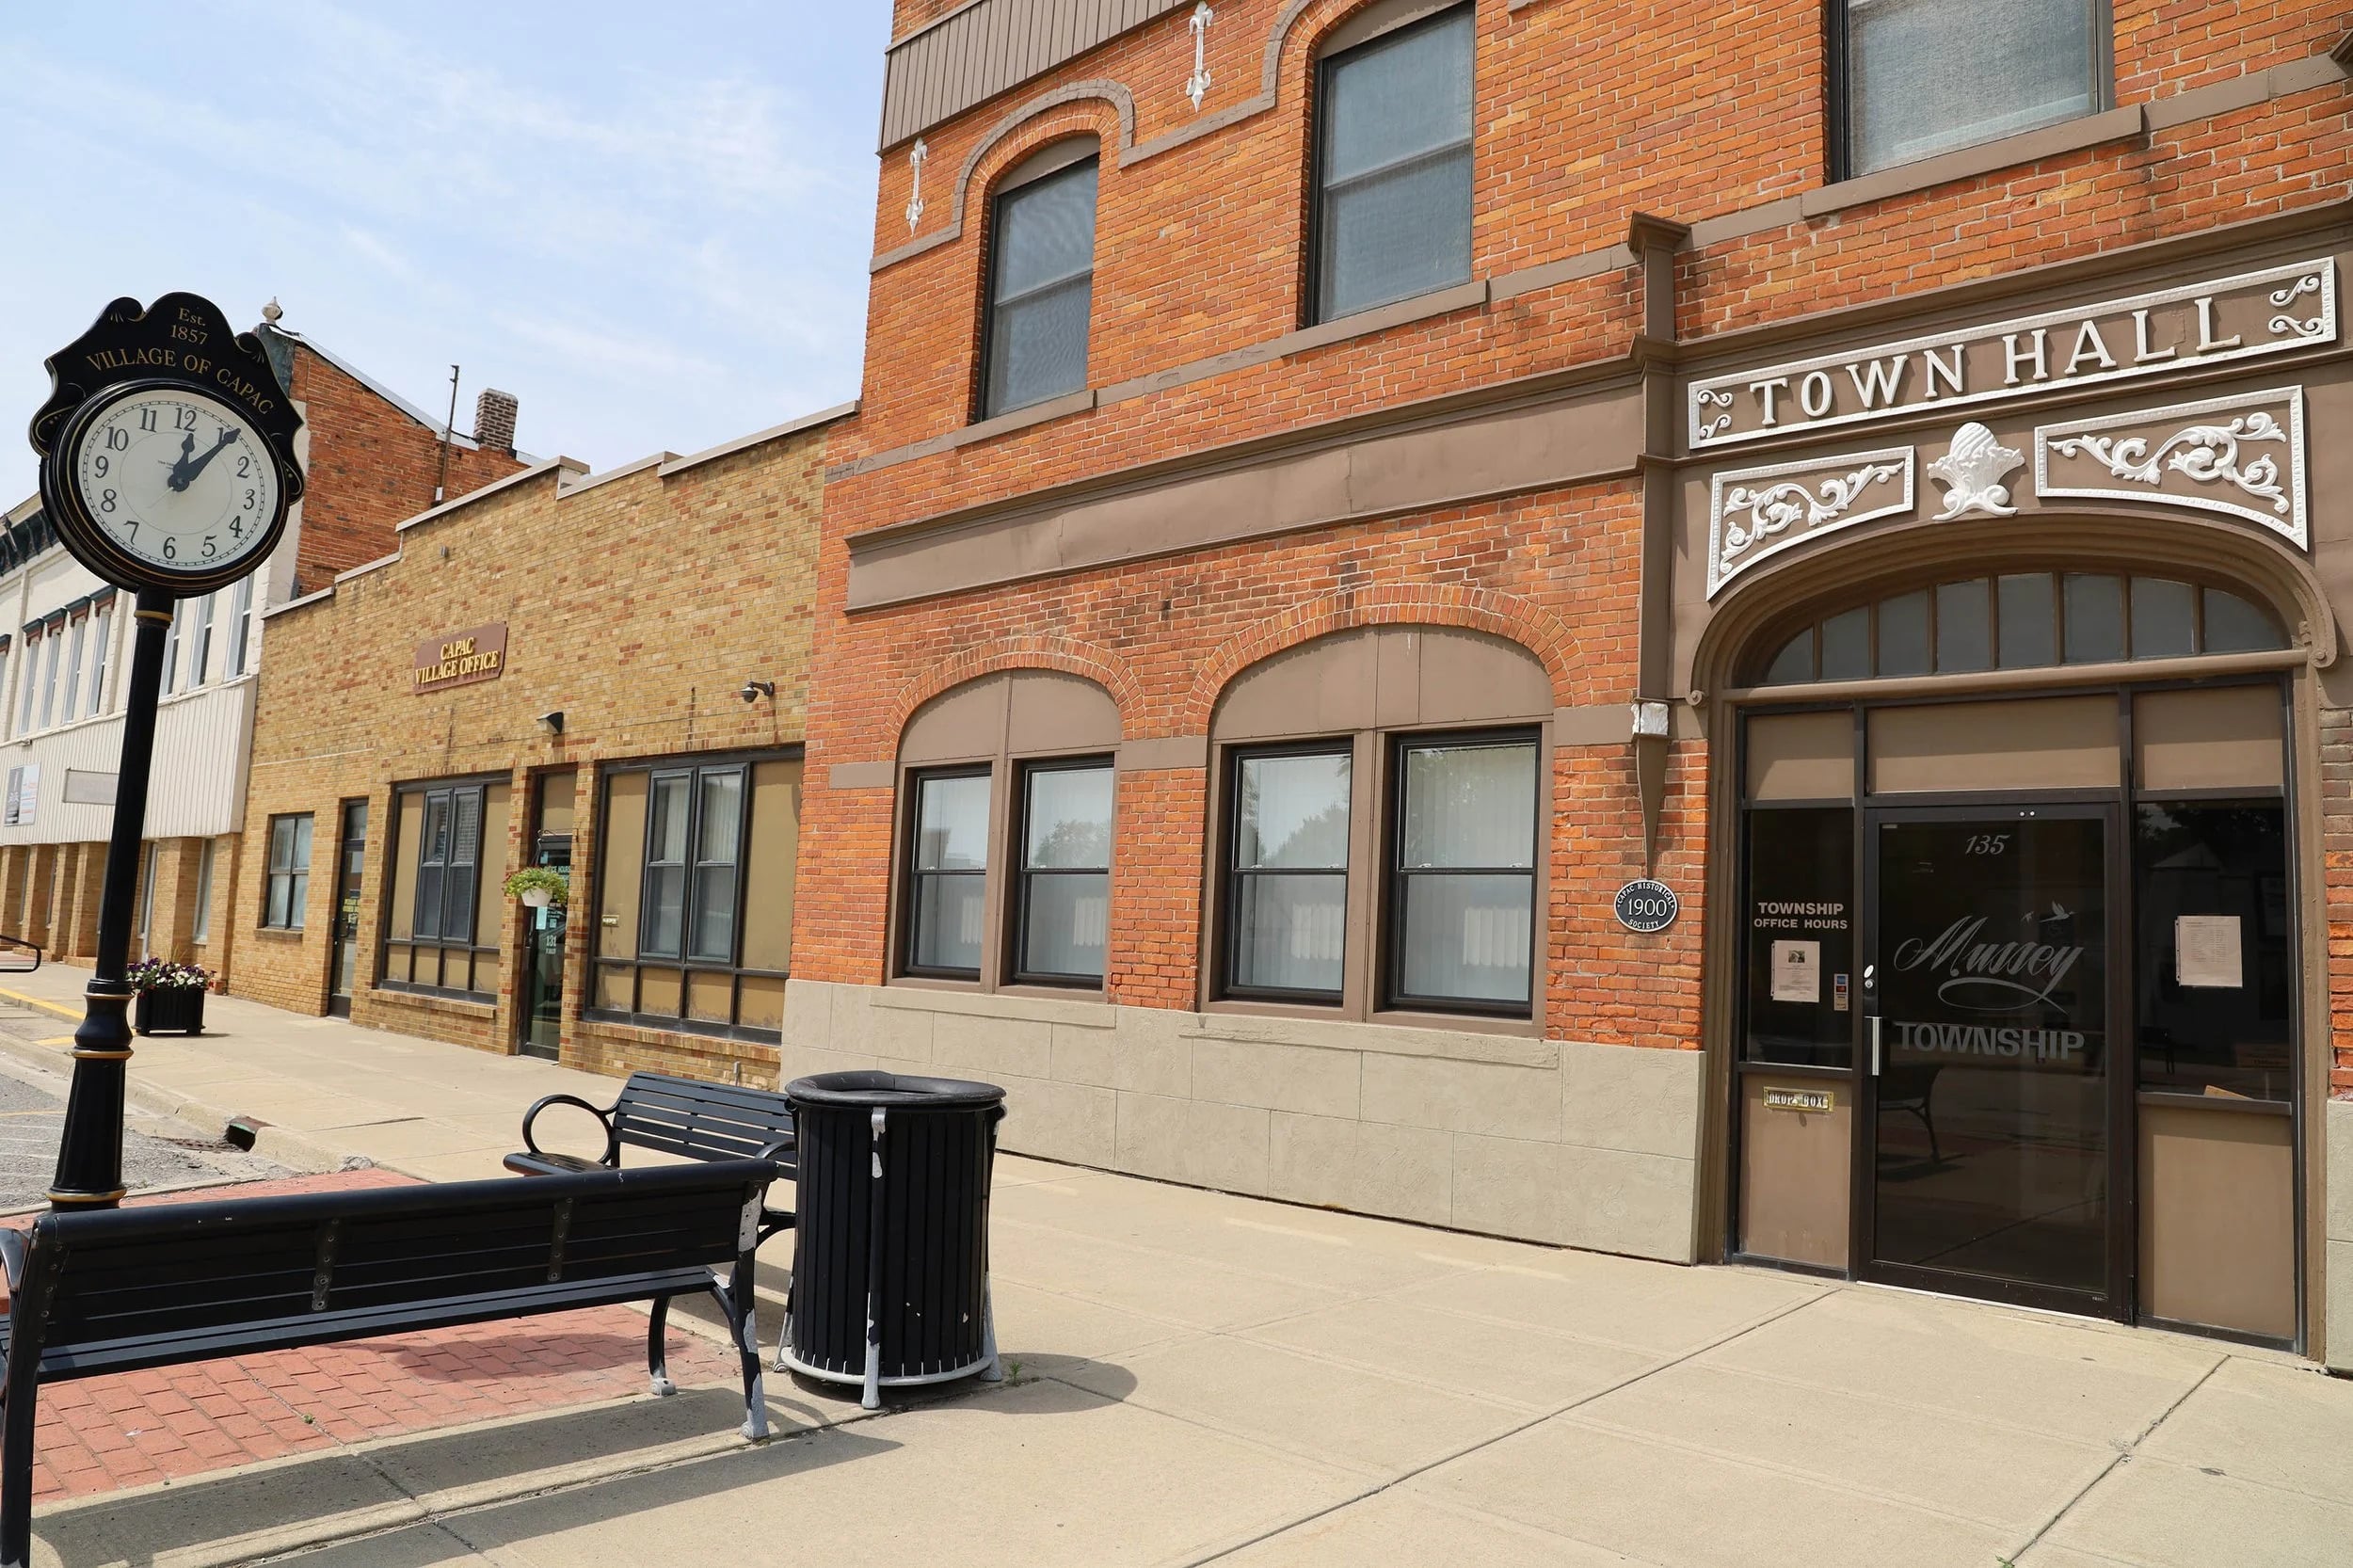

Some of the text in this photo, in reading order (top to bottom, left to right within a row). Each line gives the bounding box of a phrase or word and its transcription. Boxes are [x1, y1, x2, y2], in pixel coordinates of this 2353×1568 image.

[178, 308, 206, 327] Est.
[170, 325, 209, 345] 1857
[1749, 297, 2242, 426] TOWN HALL
[87, 347, 275, 414] VILLAGE OF CAPAC
[138, 408, 158, 432] 11
[173, 407, 198, 432] 12
[104, 426, 130, 452] 10
[94, 456, 109, 479] 9
[236, 456, 250, 479] 2
[100, 488, 117, 513] 8
[243, 488, 255, 510] 3
[123, 520, 139, 545] 7
[229, 515, 243, 538] 4
[162, 536, 177, 559] 6
[200, 536, 217, 557] 5
[440, 636, 474, 661] CAPAC
[415, 650, 499, 684] VILLAGE OFFICE
[1965, 835, 2010, 855] 135
[1617, 883, 1674, 906] CAPAC HISTORICAL
[1628, 899, 1668, 917] 1900
[1758, 902, 1845, 916] TOWNSHIP
[1627, 919, 1659, 929] SOCIETY
[1753, 919, 1849, 930] OFFICE HOURS
[1894, 915, 2085, 1015] Mussey
[1893, 1021, 2085, 1061] TOWNSHIP
[1803, 1095, 1824, 1108] BOX
